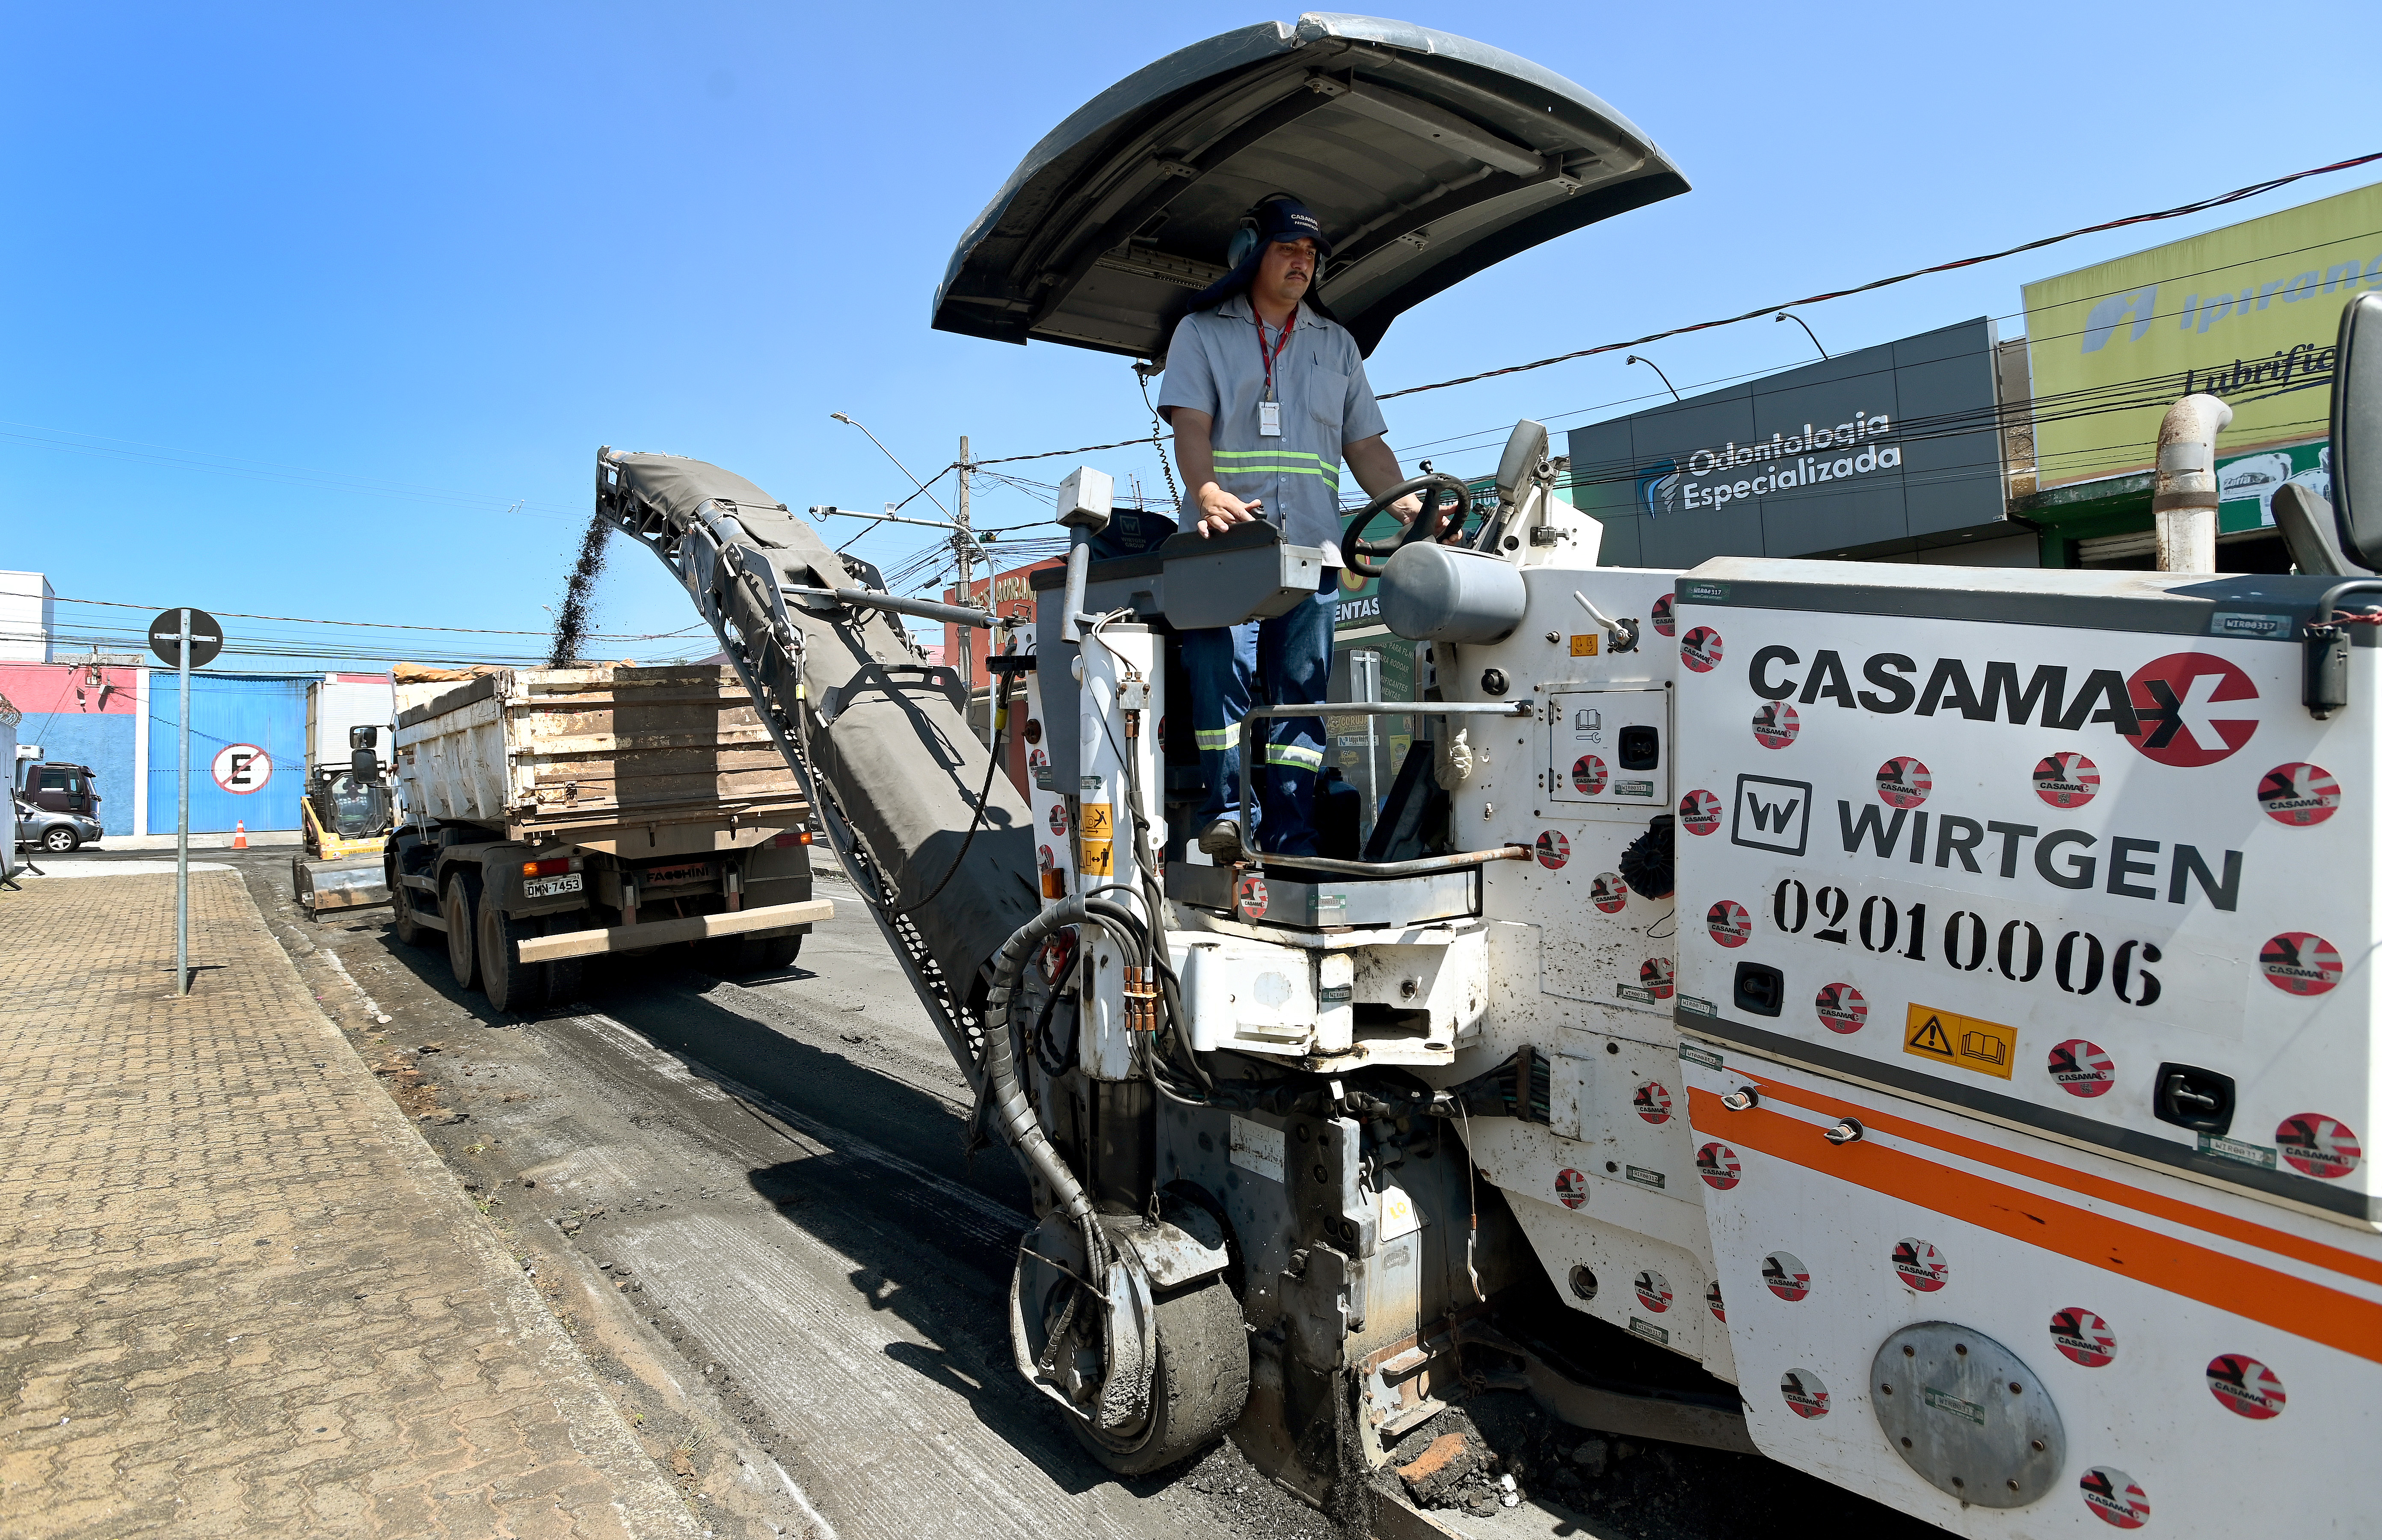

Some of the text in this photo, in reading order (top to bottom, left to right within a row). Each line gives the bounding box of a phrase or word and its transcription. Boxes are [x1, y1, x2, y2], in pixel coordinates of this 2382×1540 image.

[2180, 254, 2382, 333] Ipirang
[1689, 411, 1888, 477] Odontologia
[1683, 443, 1901, 511] Especializada
[1335, 597, 1380, 621] ENTAS
[2227, 620, 2275, 629] WIR00317
[1389, 643, 1403, 654] PARA
[1390, 660, 1410, 674] RODOAR
[1381, 675, 1408, 693] RIFICANTES
[1381, 686, 1401, 701] MENTAS
[231, 754, 251, 784] E
[1838, 800, 2243, 912] WIRTGEN
[646, 867, 709, 883] FACCHINI
[1626, 990, 1649, 998] WIR00317
[1683, 999, 1709, 1011] WIR00317
[1634, 1171, 1657, 1182] WIR00317
[1638, 1324, 1661, 1336] WIR00317
